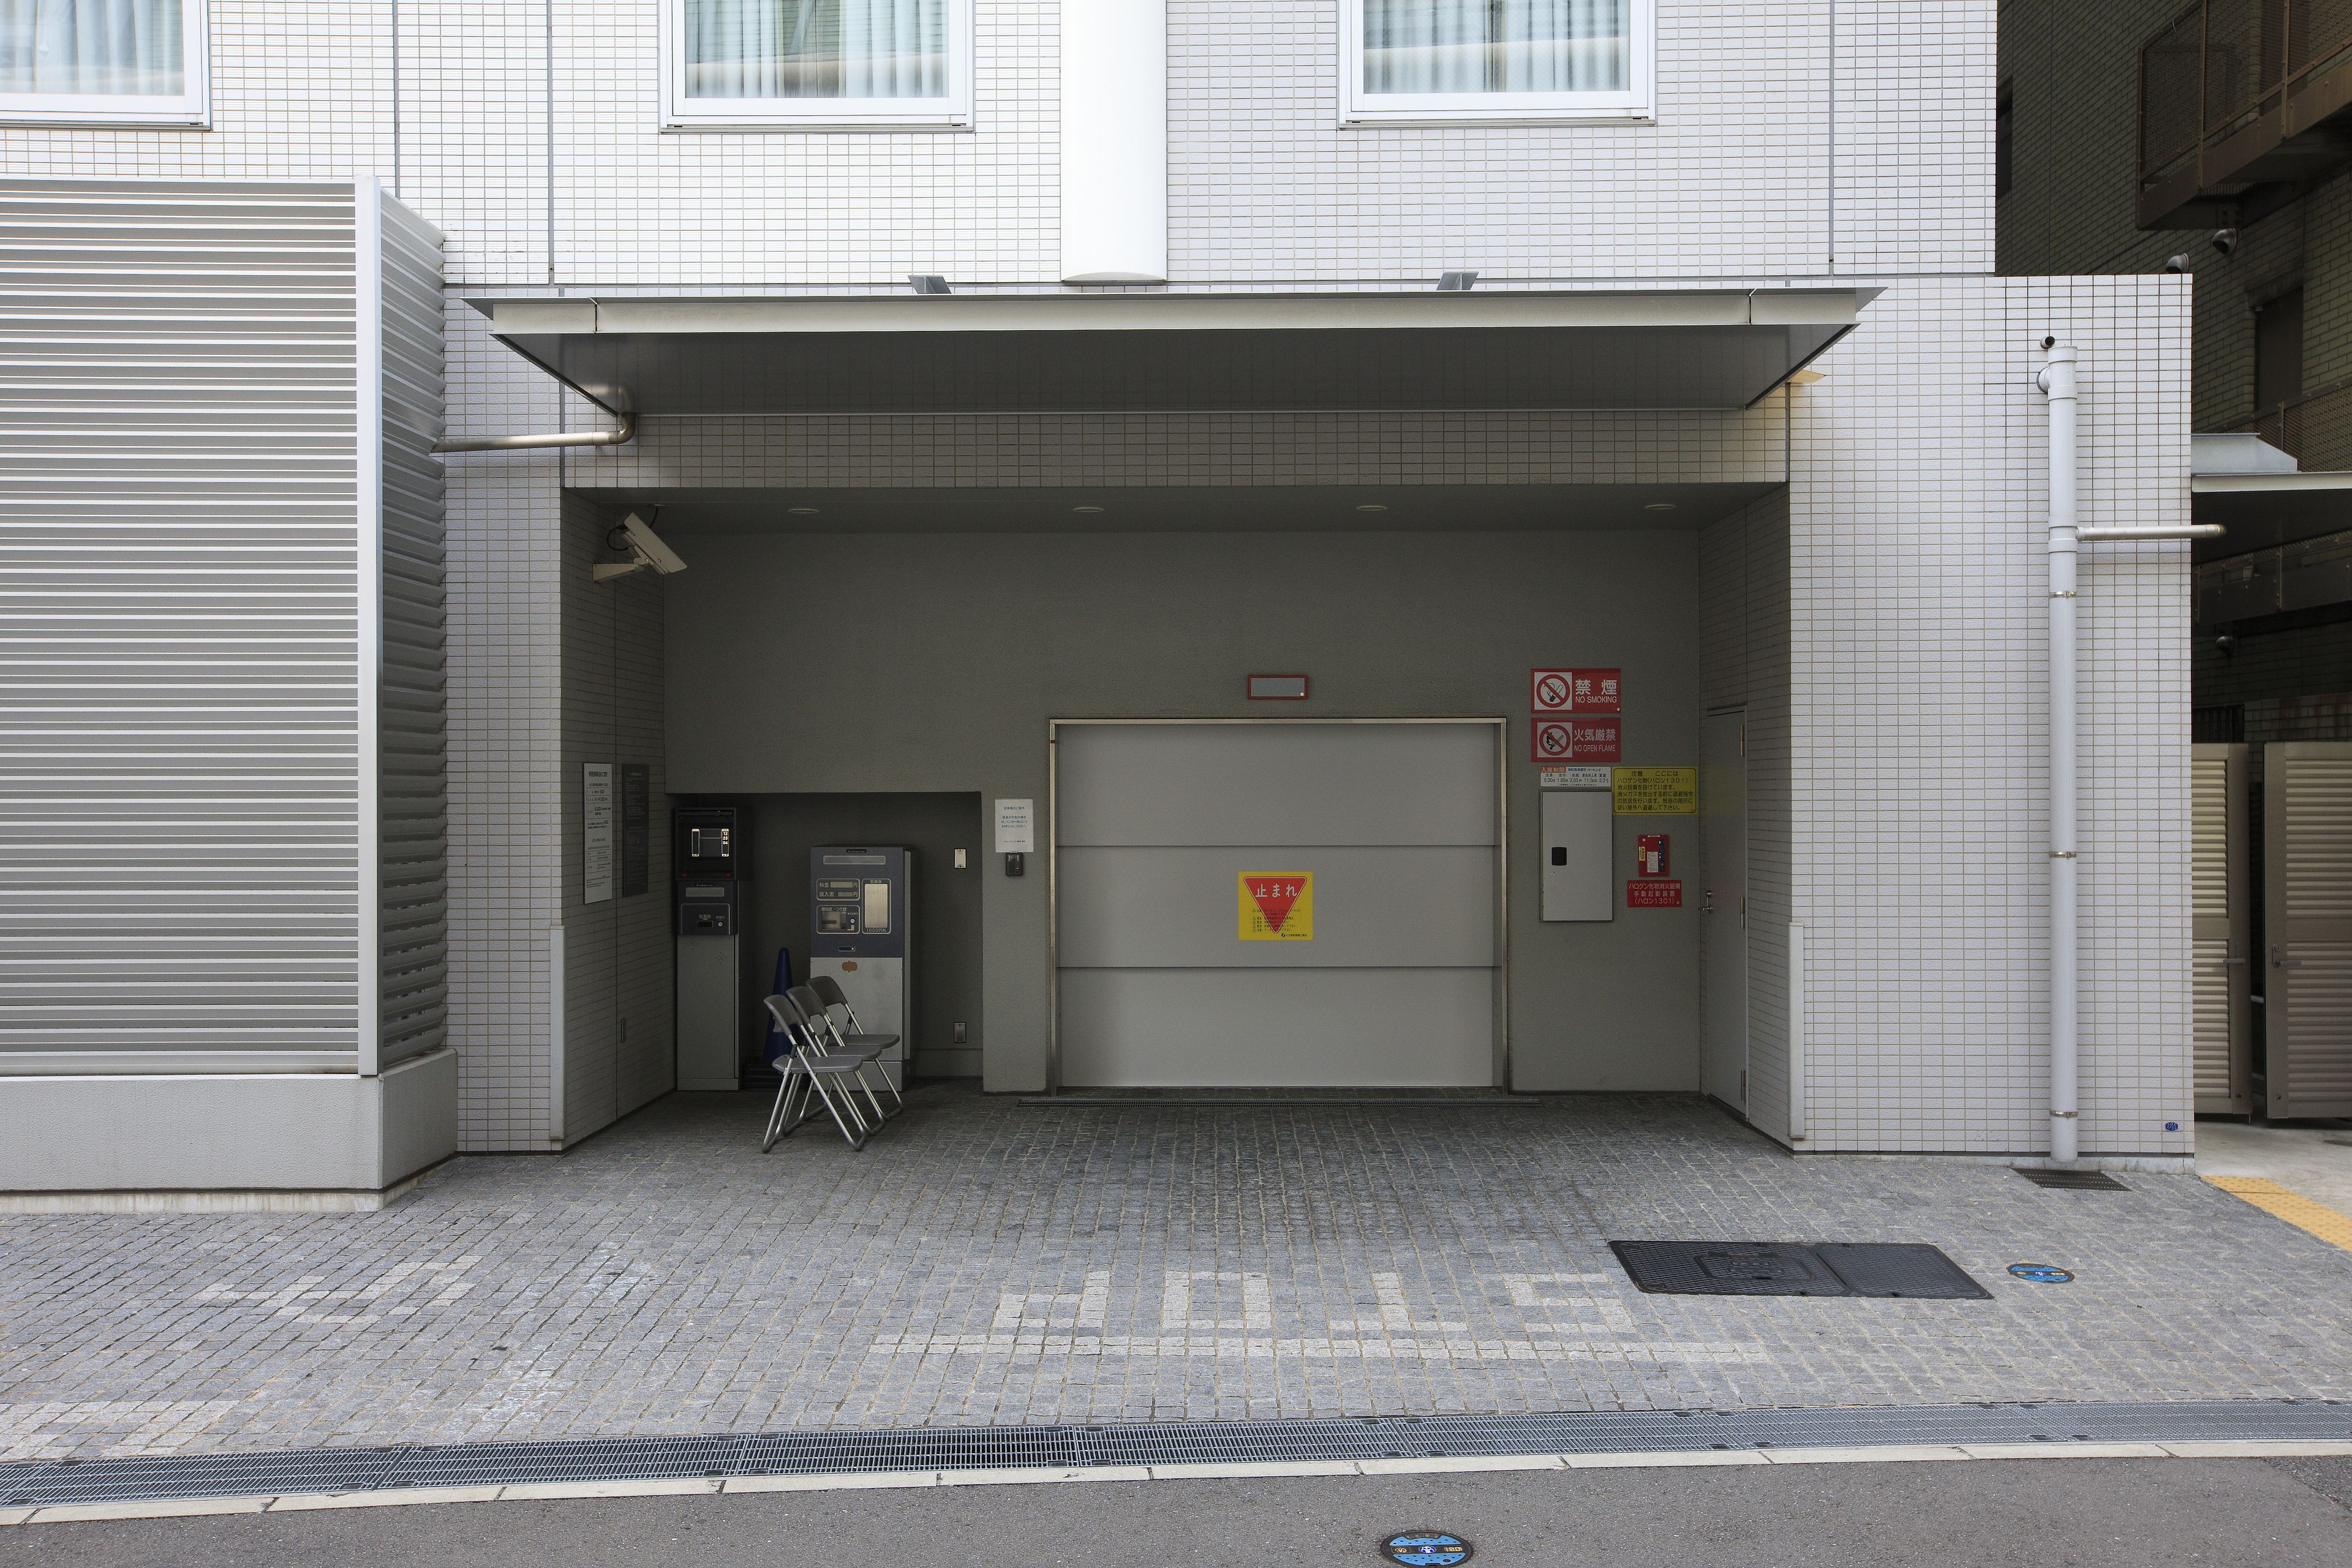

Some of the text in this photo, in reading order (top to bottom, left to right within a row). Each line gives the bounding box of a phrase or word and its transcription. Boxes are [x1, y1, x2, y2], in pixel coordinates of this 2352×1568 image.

[1575, 679, 1617, 695] 禁煙
[1574, 728, 1616, 741] 火気厳禁
[1255, 883, 1297, 897] 止まれ
